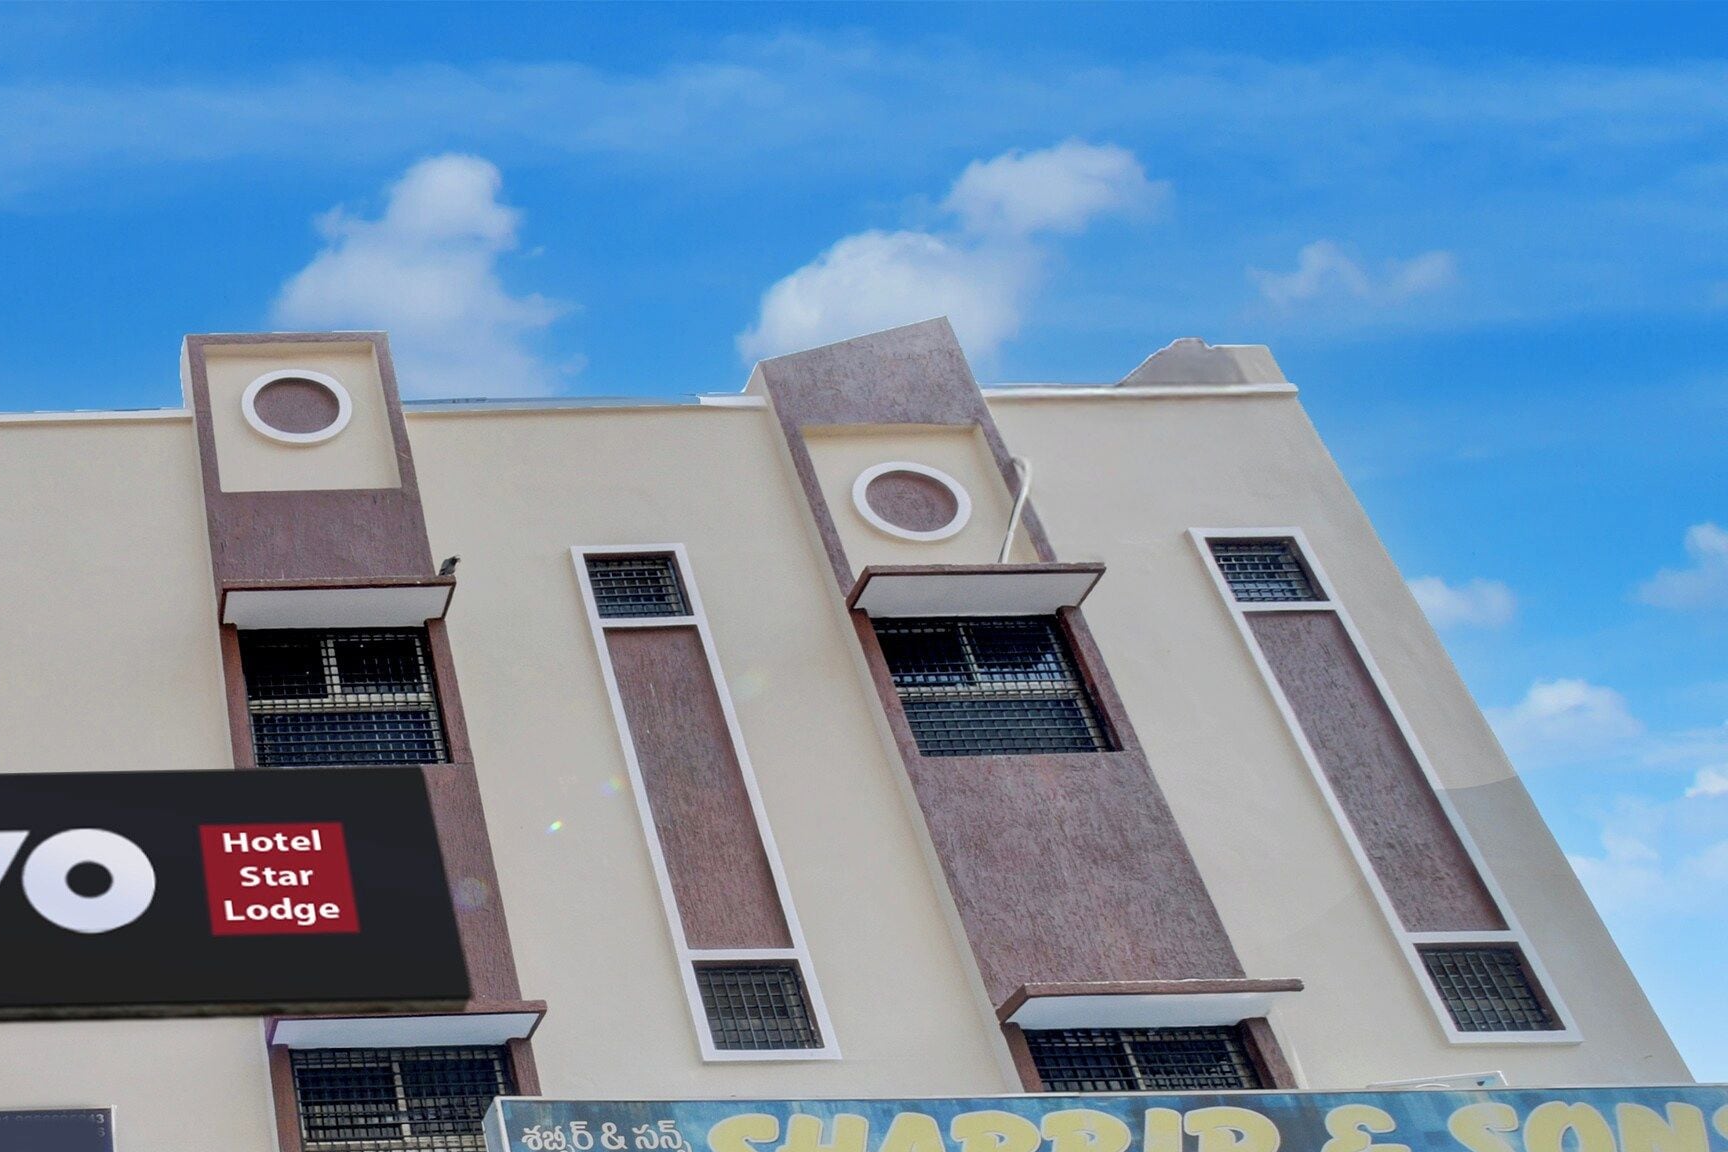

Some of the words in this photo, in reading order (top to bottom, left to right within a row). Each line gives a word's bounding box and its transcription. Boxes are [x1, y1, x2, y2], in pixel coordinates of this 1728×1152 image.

[222, 829, 322, 853] Hotel
[239, 866, 314, 887] Star
[224, 897, 341, 926] Lodge
[601, 1122, 628, 1150] &
